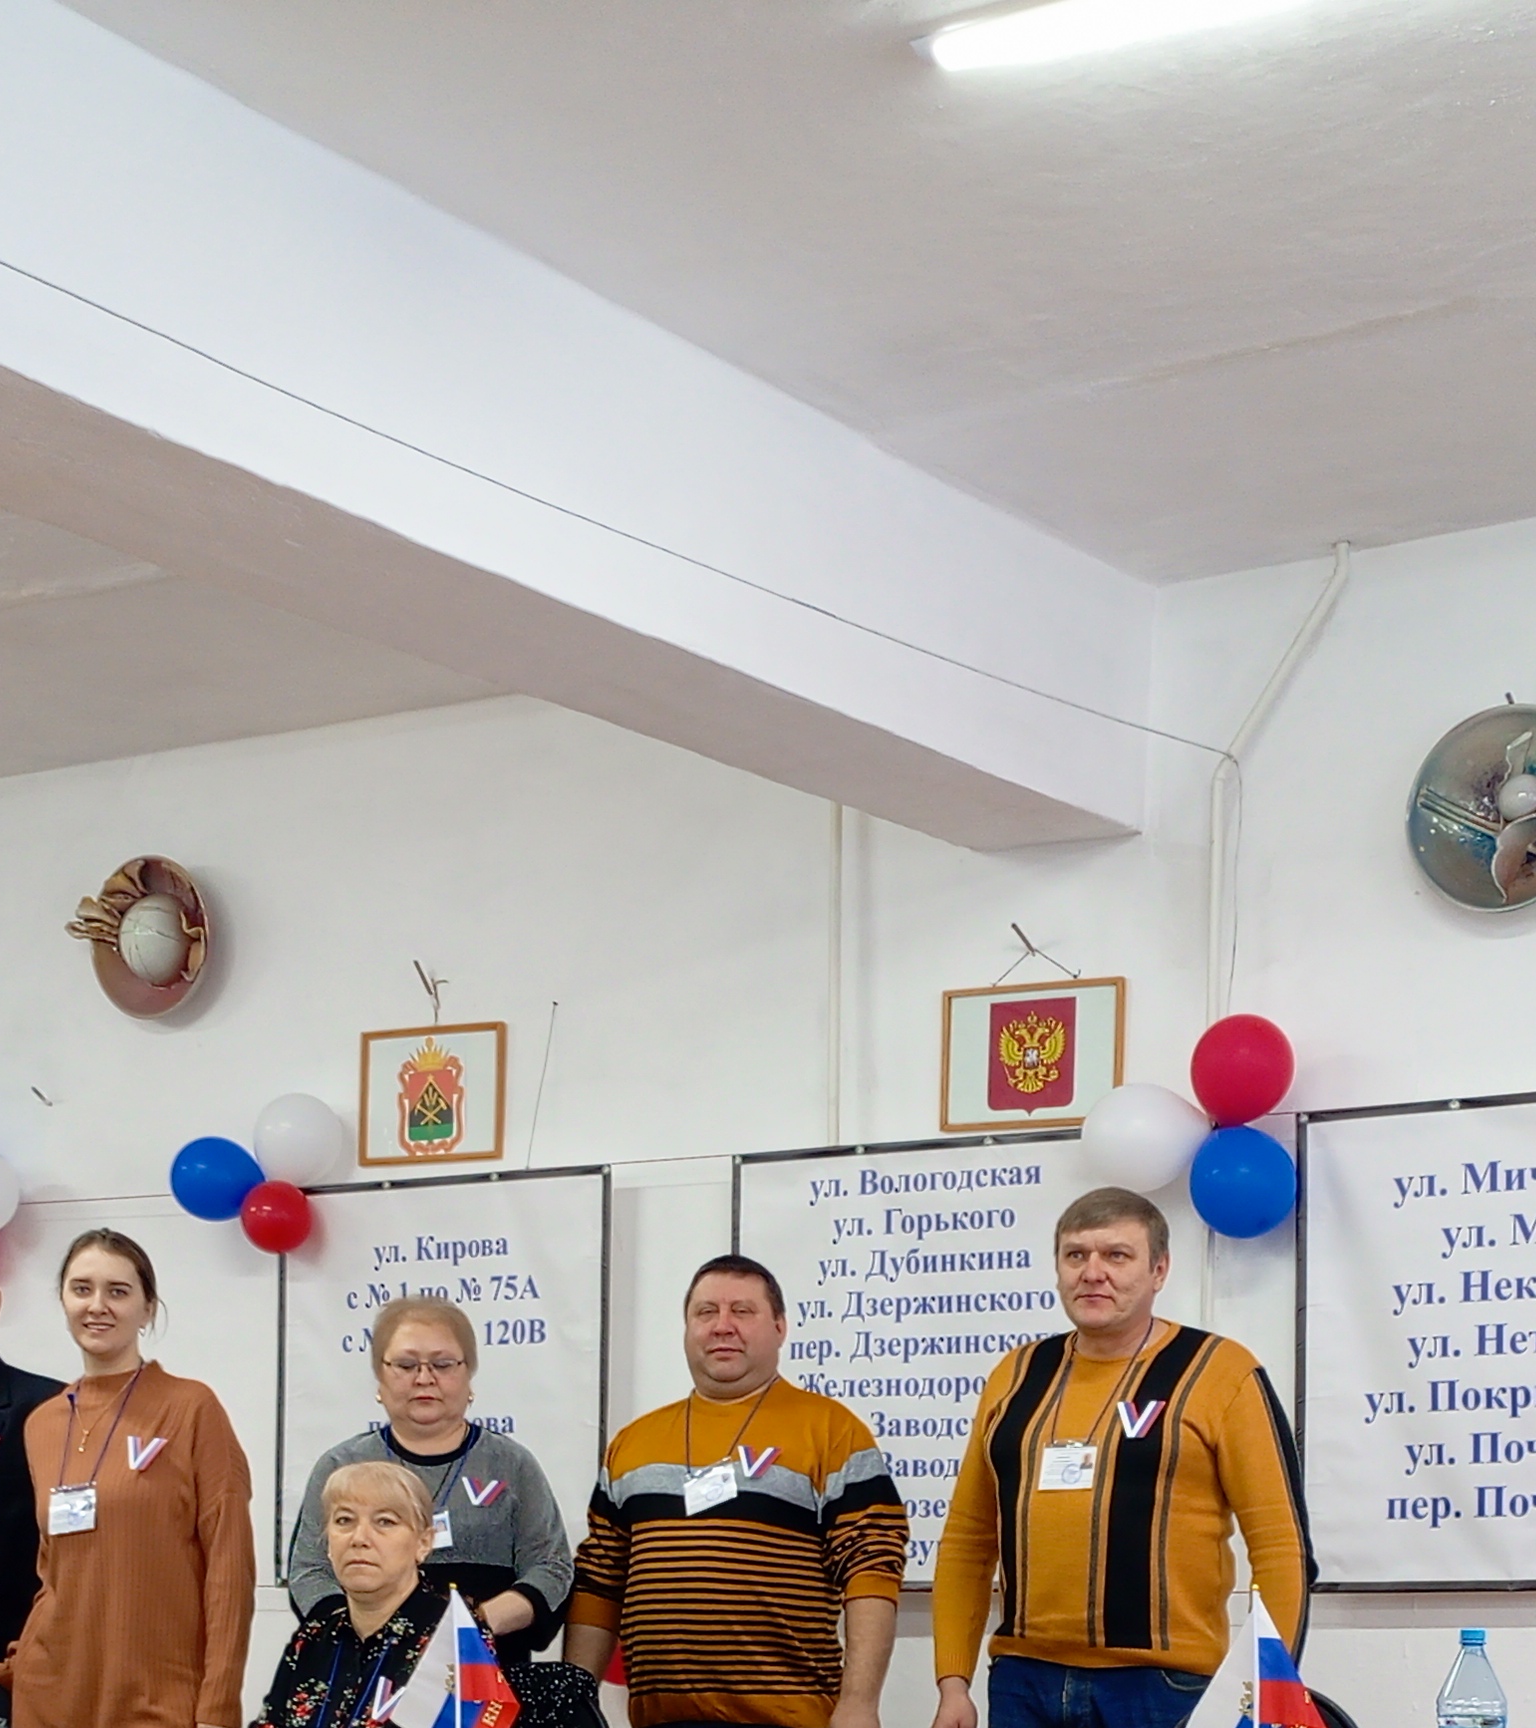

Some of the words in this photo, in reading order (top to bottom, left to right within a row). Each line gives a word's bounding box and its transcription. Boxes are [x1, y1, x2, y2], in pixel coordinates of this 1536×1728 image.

[809, 1179, 849, 1207] ул.
[860, 1165, 1041, 1195] Вологодская
[1393, 1174, 1448, 1209] ул.
[831, 1217, 873, 1246] ул.
[885, 1208, 1016, 1241] Горького
[1441, 1225, 1496, 1260] ул.
[373, 1245, 407, 1272] ул.
[416, 1235, 509, 1267] Кирова
[817, 1258, 857, 1287] ул.
[864, 1248, 1031, 1283] Дубинкина
[346, 1291, 358, 1310] с
[455, 1277, 482, 1304] №
[490, 1274, 540, 1301] 75А
[797, 1300, 833, 1328] ул.
[841, 1290, 1056, 1323] Дзержинского
[1392, 1282, 1446, 1316] ул.
[484, 1318, 546, 1346] 120В
[790, 1339, 841, 1366] пер.
[850, 1331, 1061, 1364] Дзержинско
[1407, 1335, 1461, 1369] ул.
[798, 1372, 986, 1403] Железнодоро
[1364, 1391, 1416, 1424] ул.
[870, 1411, 975, 1441] Заводс
[881, 1451, 961, 1481] Завод
[1405, 1443, 1456, 1476] ул.
[1387, 1496, 1462, 1529] пер.
